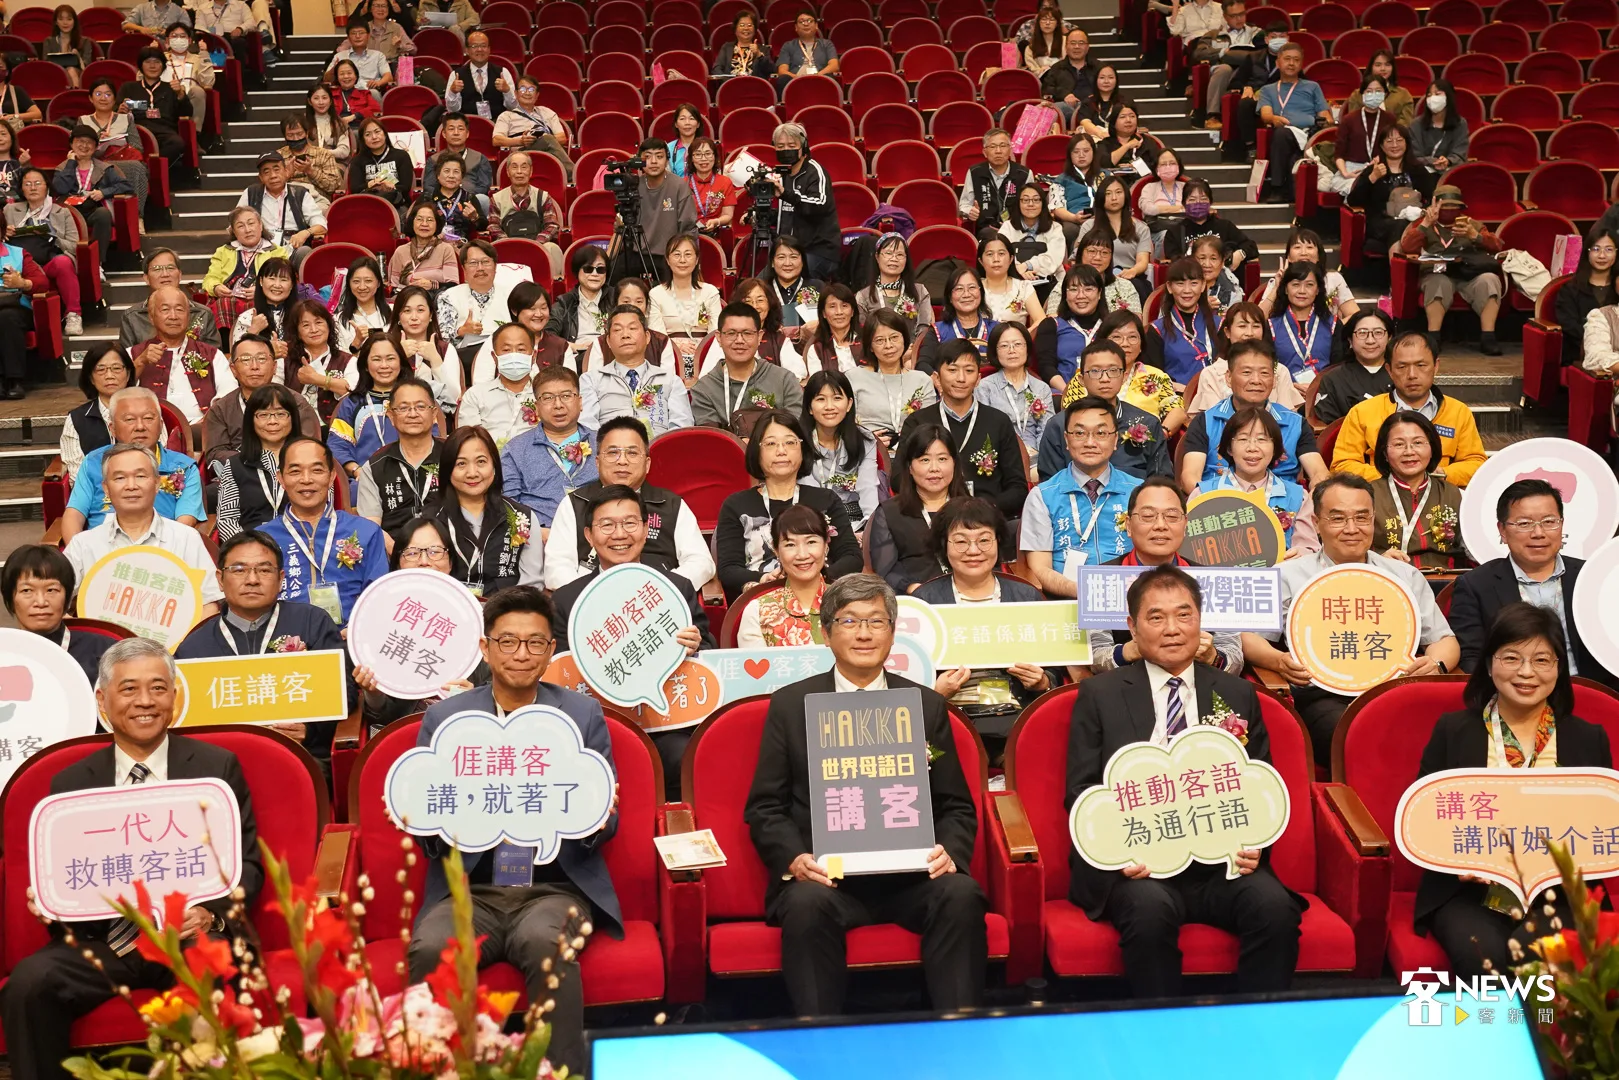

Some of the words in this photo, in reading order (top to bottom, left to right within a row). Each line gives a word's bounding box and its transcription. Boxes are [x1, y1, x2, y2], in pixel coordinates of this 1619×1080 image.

[1187, 506, 1256, 537] 推動客語
[1385, 518, 1400, 551] 劉淑
[1191, 526, 1262, 566] HAKKA
[112, 562, 187, 595] 推動客語
[103, 582, 177, 628] HAKKA
[392, 596, 457, 646] 儕儕
[586, 580, 663, 659] 推動客語
[1322, 595, 1384, 625] 時時
[603, 609, 679, 686] 教學語言
[952, 622, 1081, 645] 客語係通行語
[1329, 630, 1393, 661] 講客
[378, 629, 446, 680] 講客
[772, 653, 821, 678] 客家
[818, 706, 913, 749] HAKKA
[821, 753, 915, 781] 世界母語日
[1113, 761, 1241, 812] 推動客語
[824, 783, 921, 832] 講客
[1122, 797, 1249, 848] 為通行語
[1435, 791, 1500, 821] 講客
[84, 809, 189, 846] 一代人
[65, 845, 208, 891] 救轉客話
